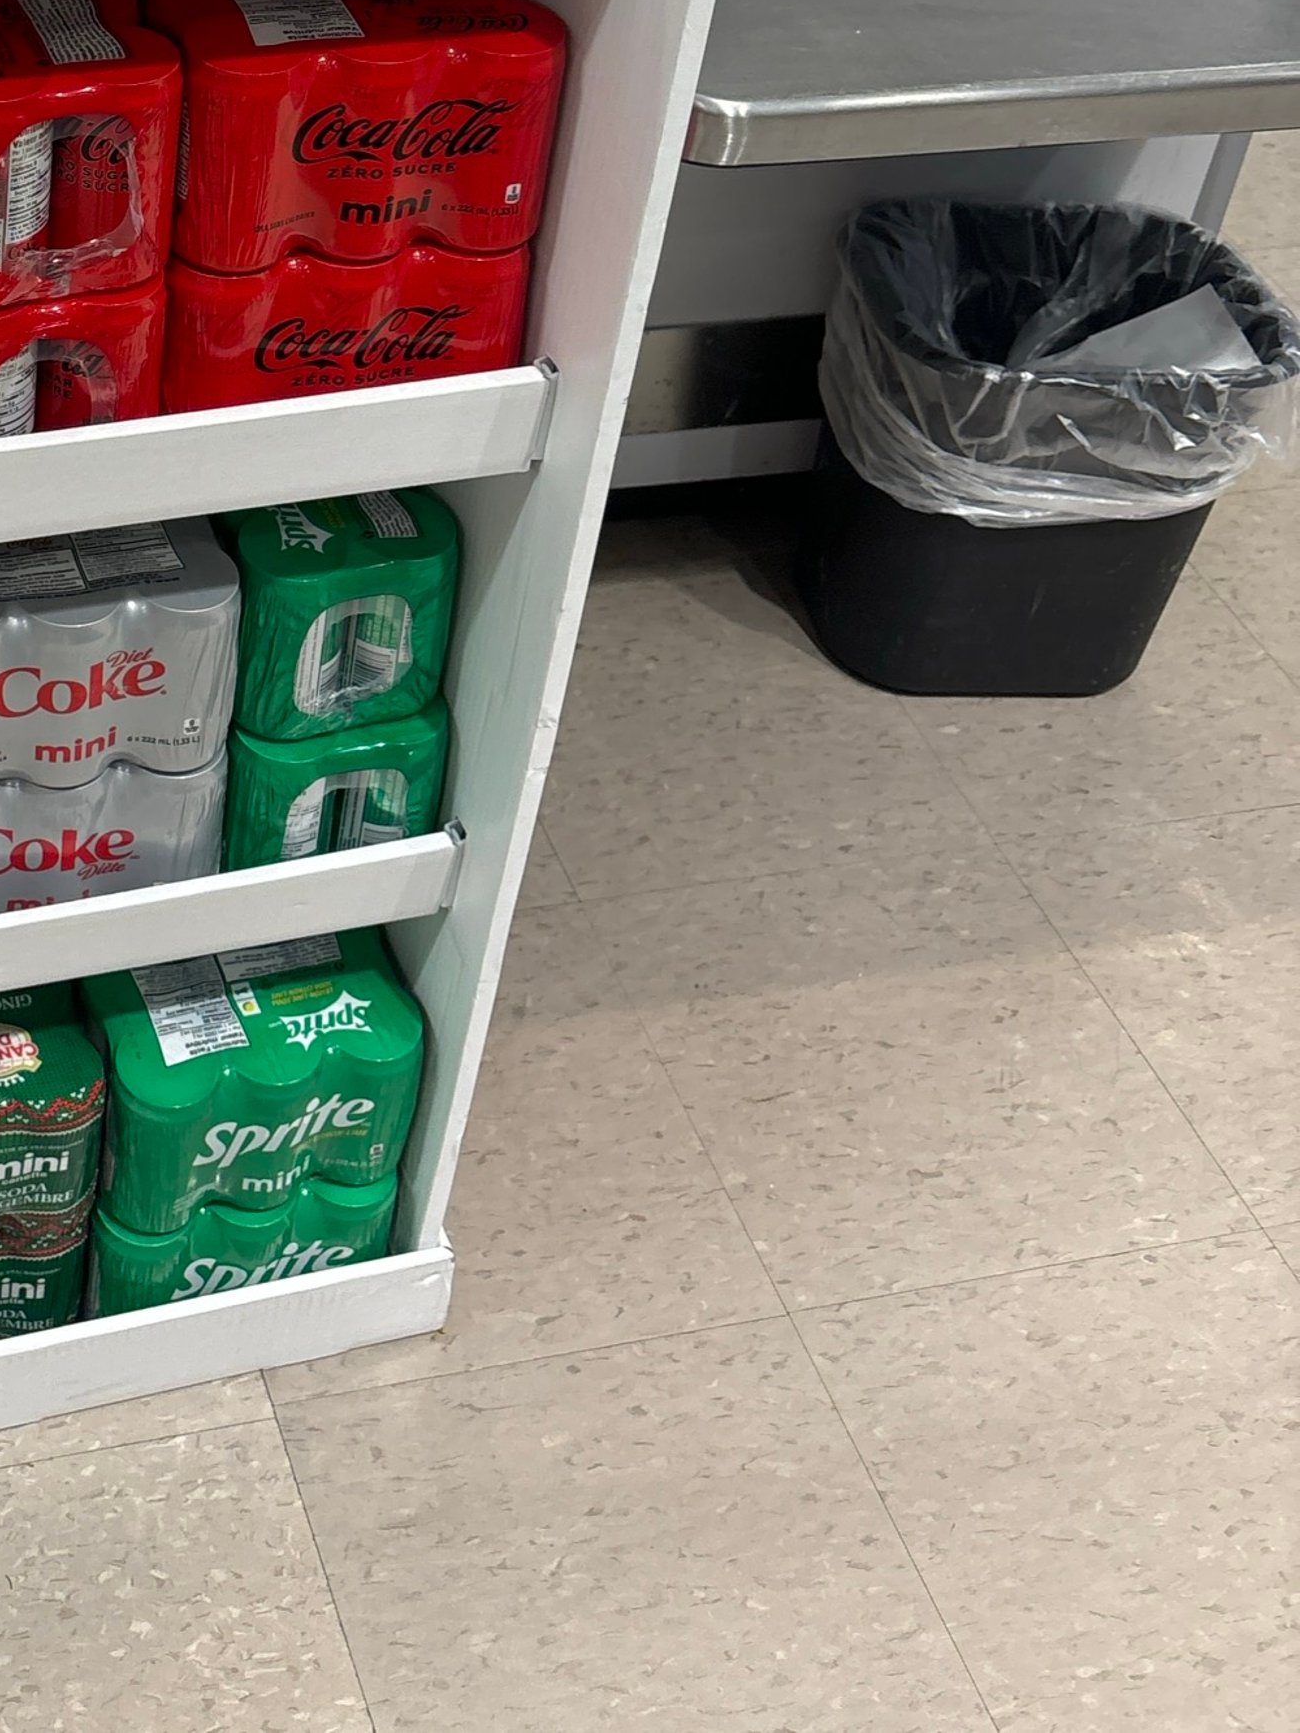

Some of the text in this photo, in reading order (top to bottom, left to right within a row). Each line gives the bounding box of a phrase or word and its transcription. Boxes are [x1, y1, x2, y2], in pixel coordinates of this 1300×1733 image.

[292, 98, 522, 164] Coca-Cola
[325, 162, 457, 180] ZÉRO SUCRE
[339, 188, 433, 226] mini
[254, 305, 476, 372] Coca-Cola
[291, 364, 416, 386] ZÉRO SUCRE
[105, 647, 154, 668] Diet
[34, 726, 118, 764] mini
[157, 736, 171, 746] mL
[286, 1002, 368, 1038] Sprite
[192, 1093, 375, 1169] Sprite
[241, 1154, 312, 1194] mini
[170, 1240, 356, 1300] Sprite
